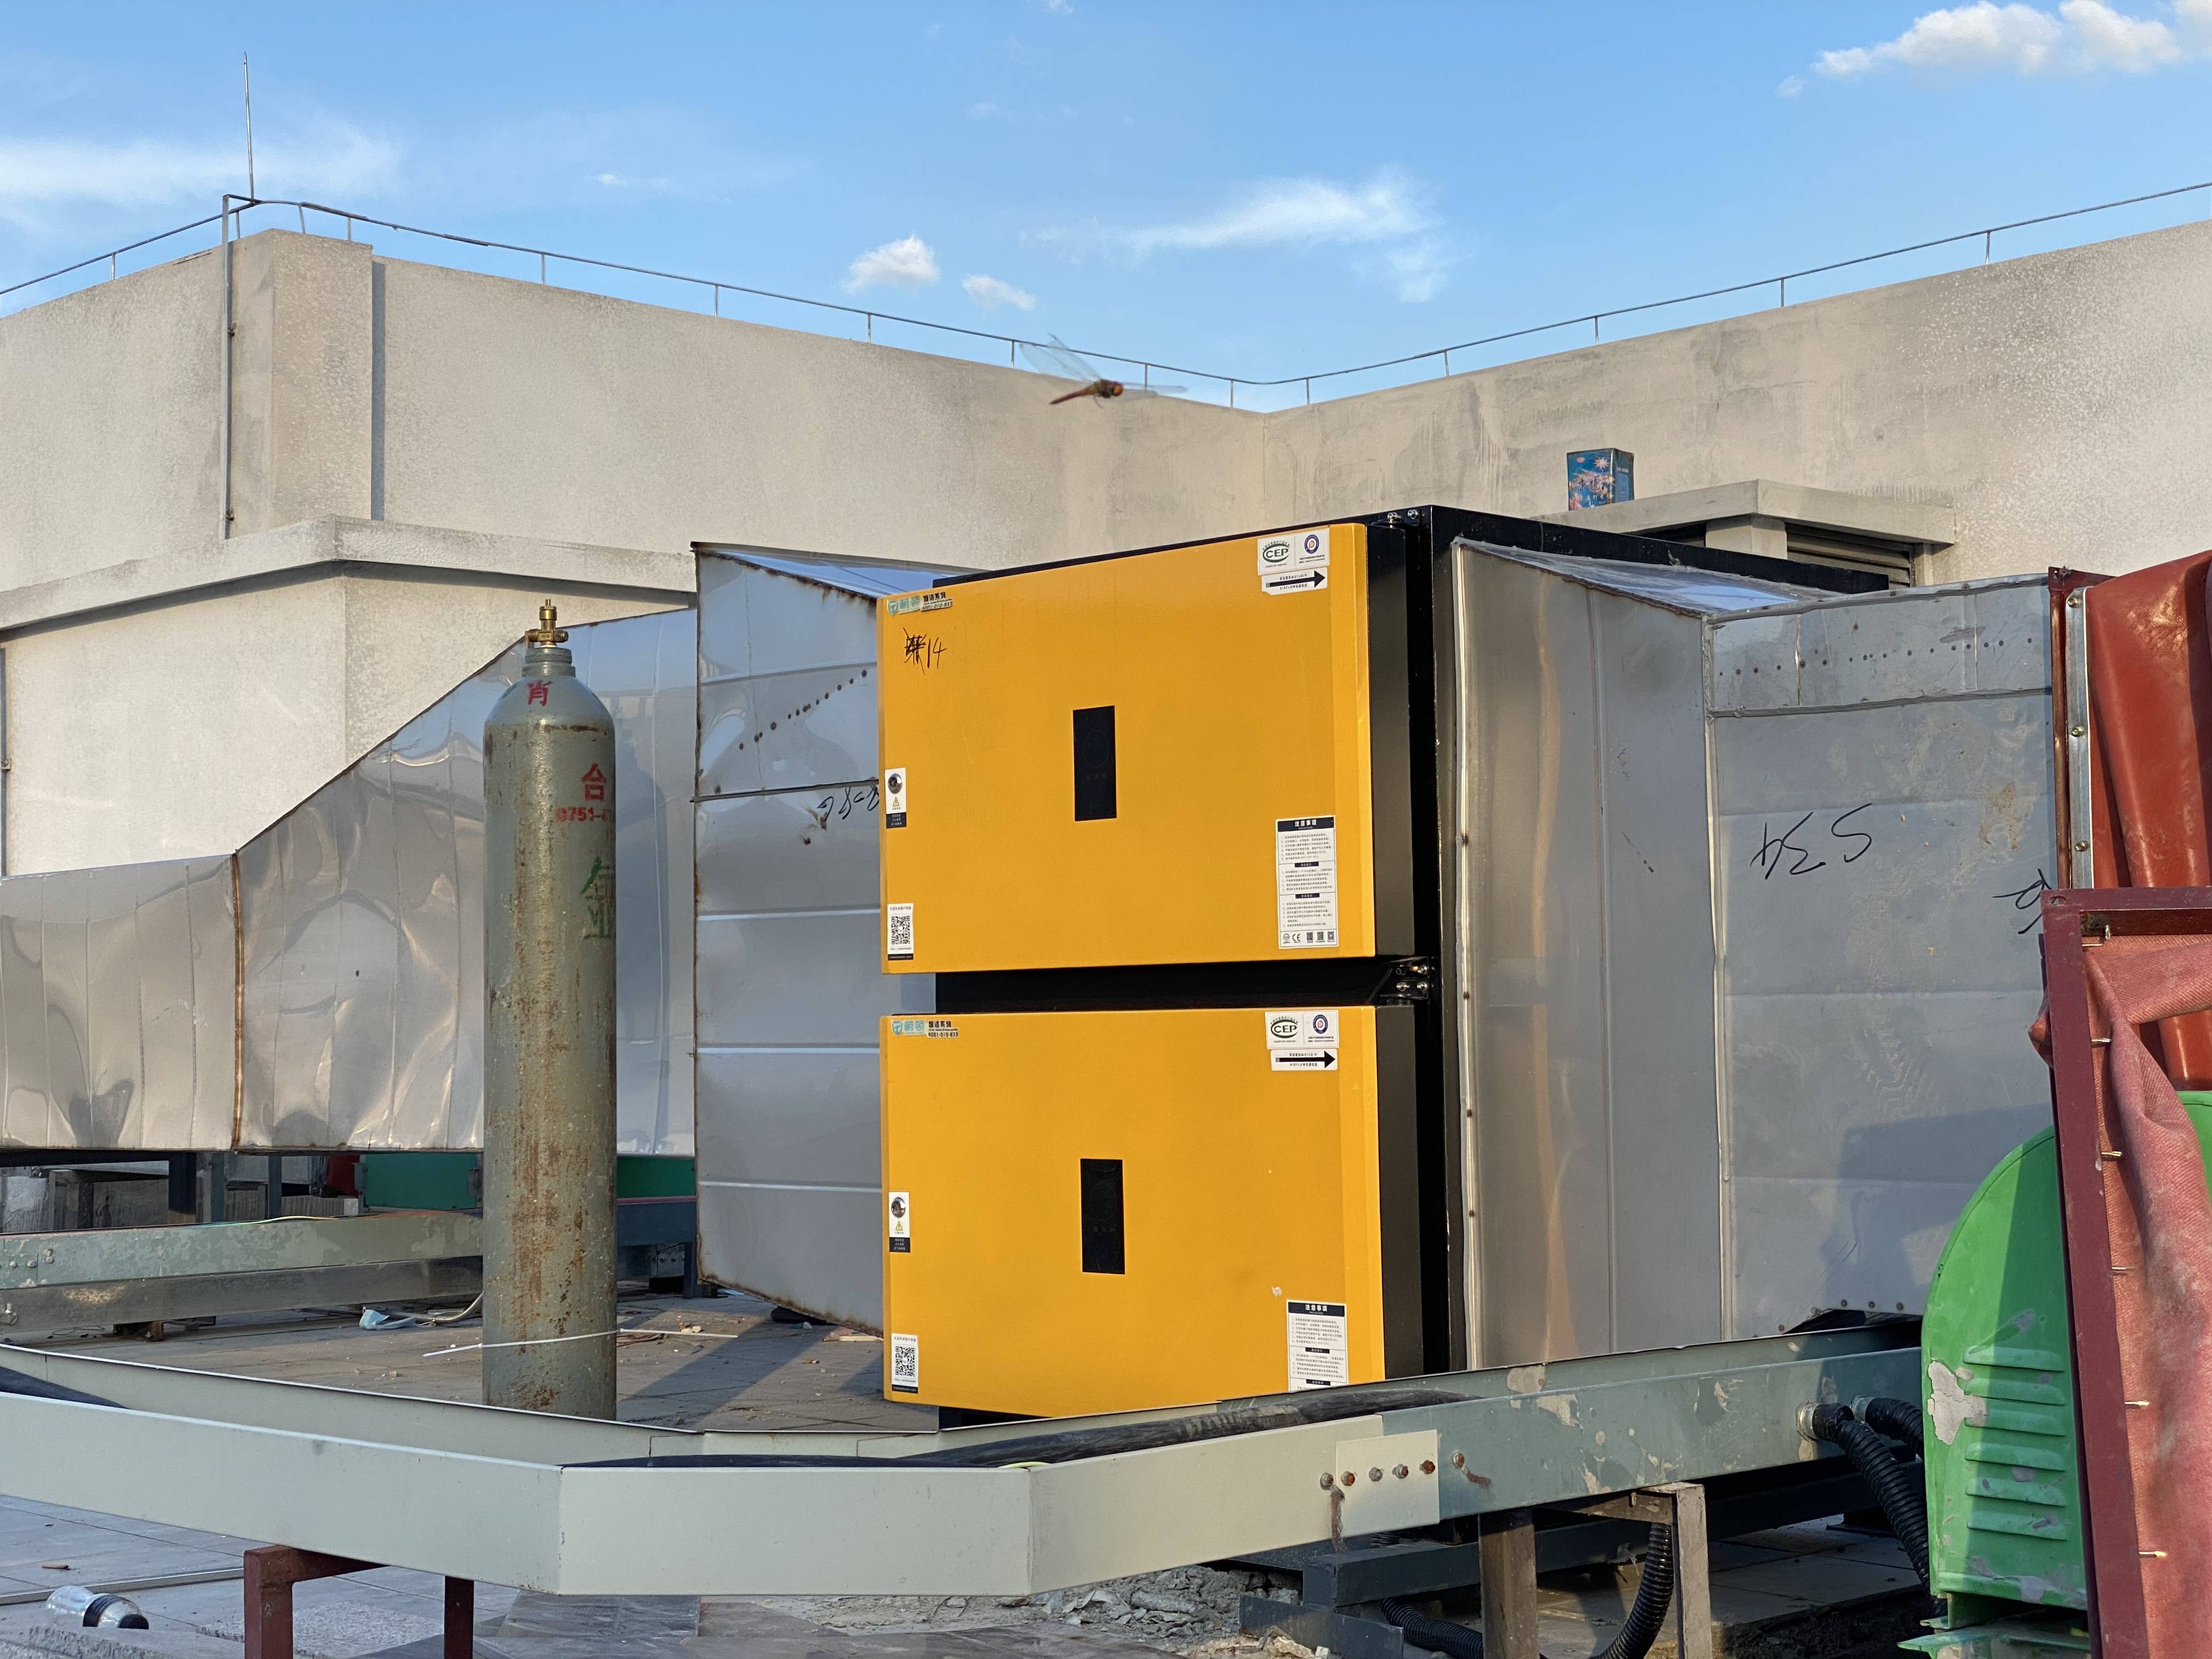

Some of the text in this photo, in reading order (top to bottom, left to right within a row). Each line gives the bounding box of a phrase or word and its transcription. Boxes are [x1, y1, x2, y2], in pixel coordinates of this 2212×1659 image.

[1266, 549, 1289, 558] CEP
[1294, 819, 1317, 827] 注意事项
[1274, 1025, 1297, 1033] CEP
